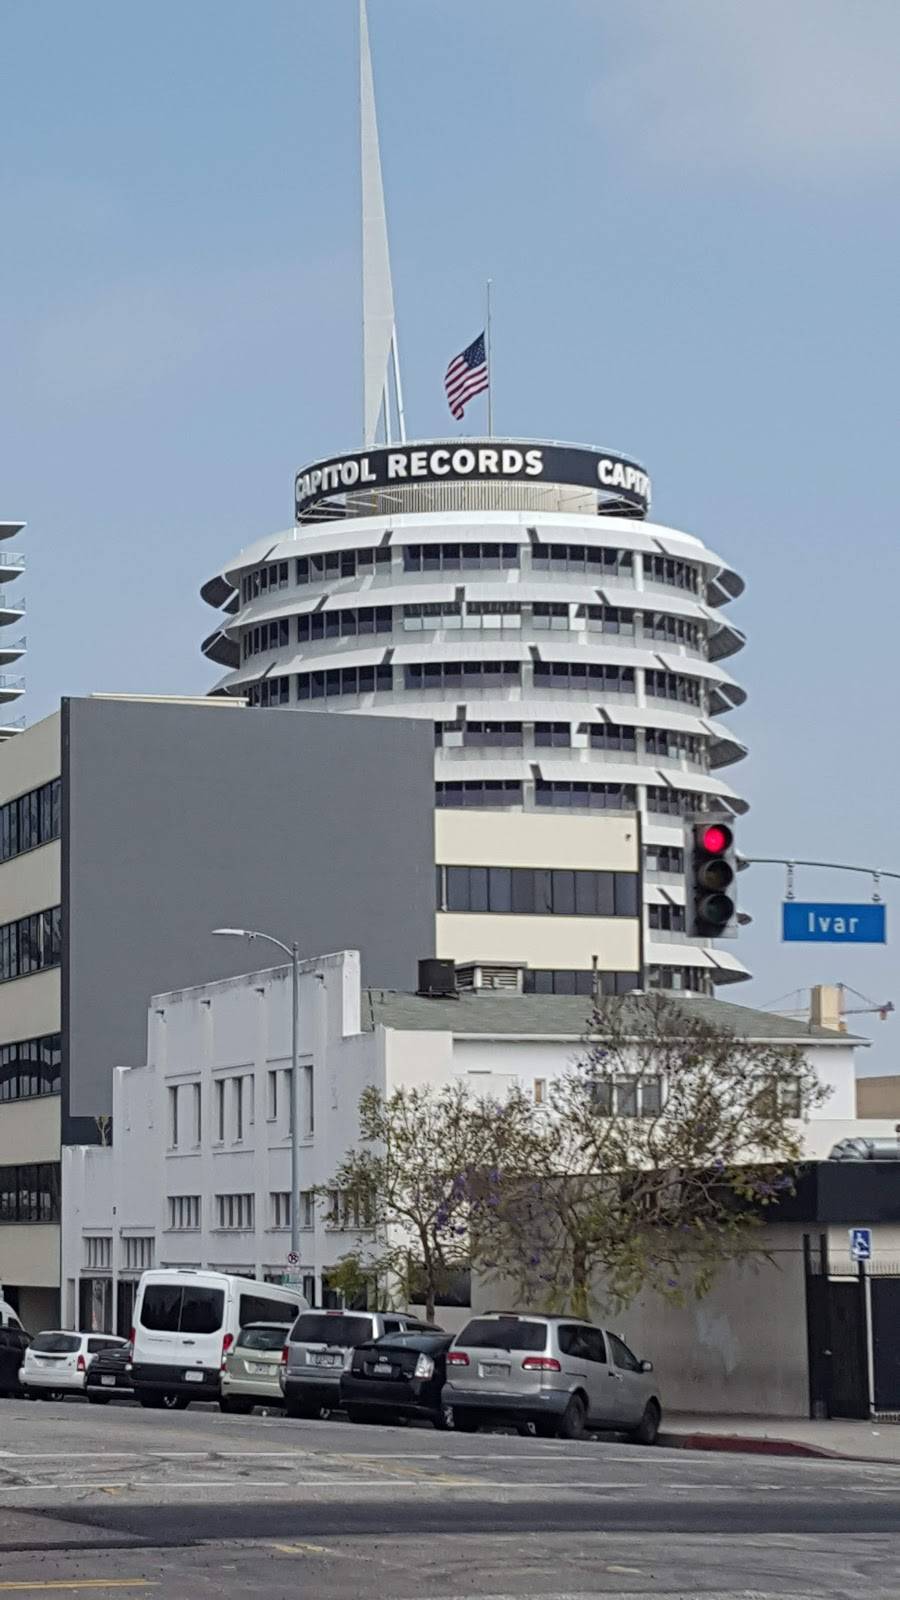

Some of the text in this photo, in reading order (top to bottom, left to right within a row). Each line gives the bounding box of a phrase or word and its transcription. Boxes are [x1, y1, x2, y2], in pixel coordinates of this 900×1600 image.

[296, 449, 544, 501] CAPITOL RECORDS
[808, 912, 859, 933] Ivar
